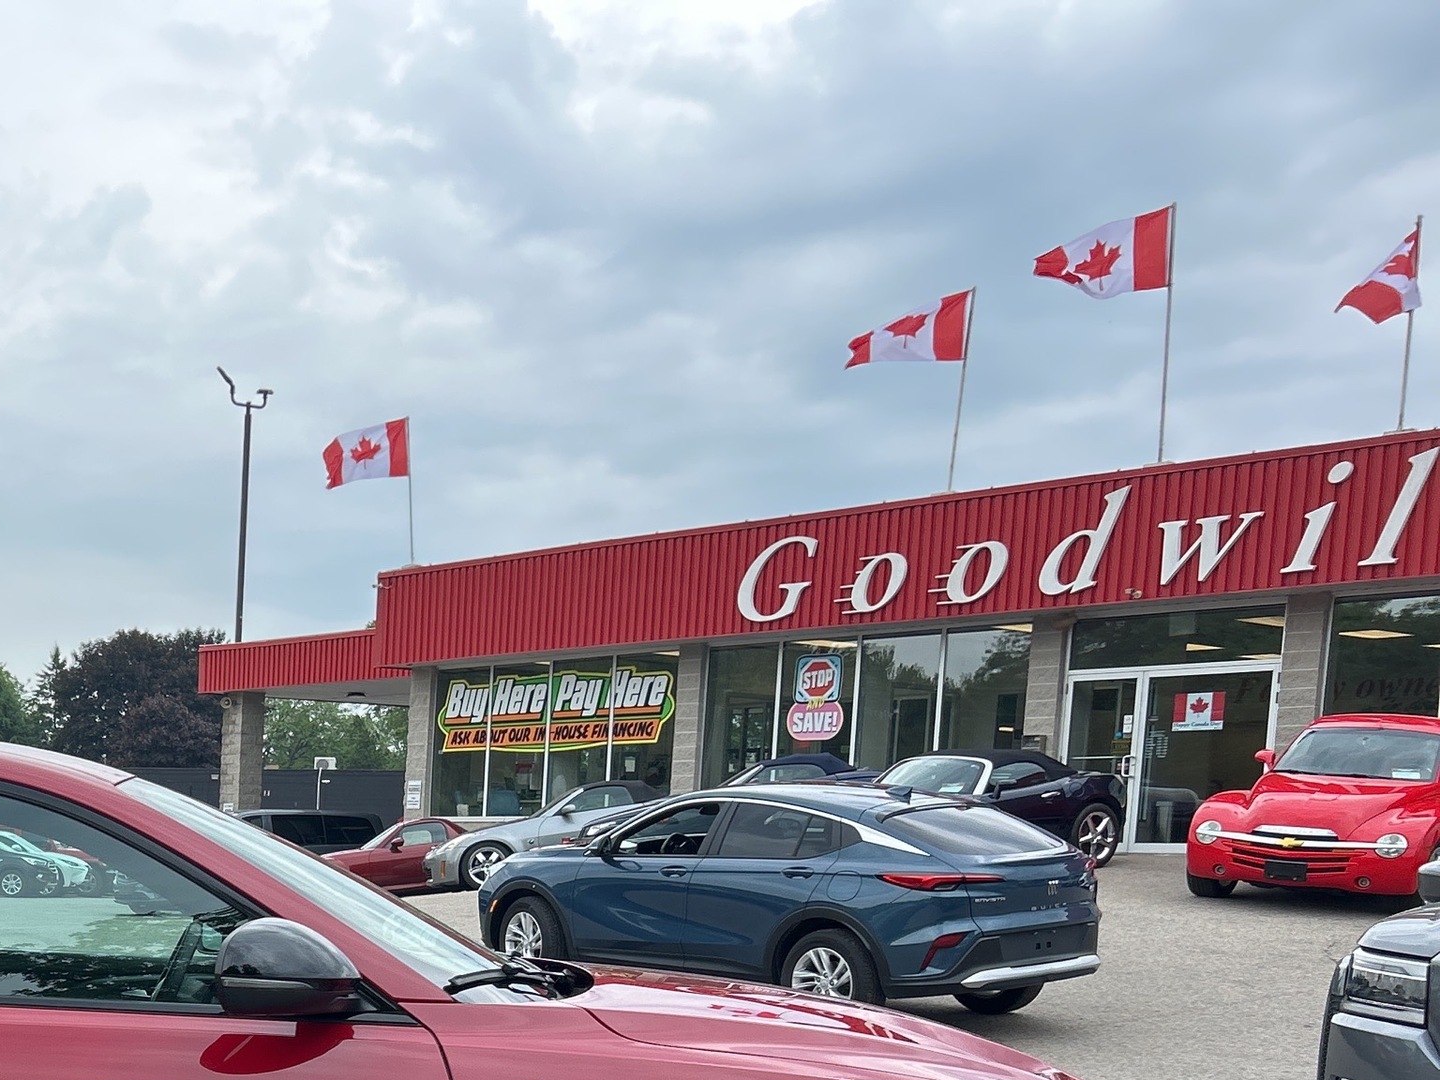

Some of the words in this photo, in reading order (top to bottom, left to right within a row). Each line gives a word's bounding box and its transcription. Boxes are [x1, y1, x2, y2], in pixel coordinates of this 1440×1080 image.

[802, 668, 834, 690] STOP
[445, 683, 489, 723] Buy
[492, 679, 548, 715] Here
[554, 675, 603, 717] Pay
[604, 670, 668, 709] Here
[805, 697, 826, 711] AND
[792, 711, 839, 732] SAVE!
[450, 731, 472, 746] ASK
[508, 727, 532, 743] OUR
[533, 723, 590, 742] IN-HOUSE
[590, 720, 654, 739] FINANCING
